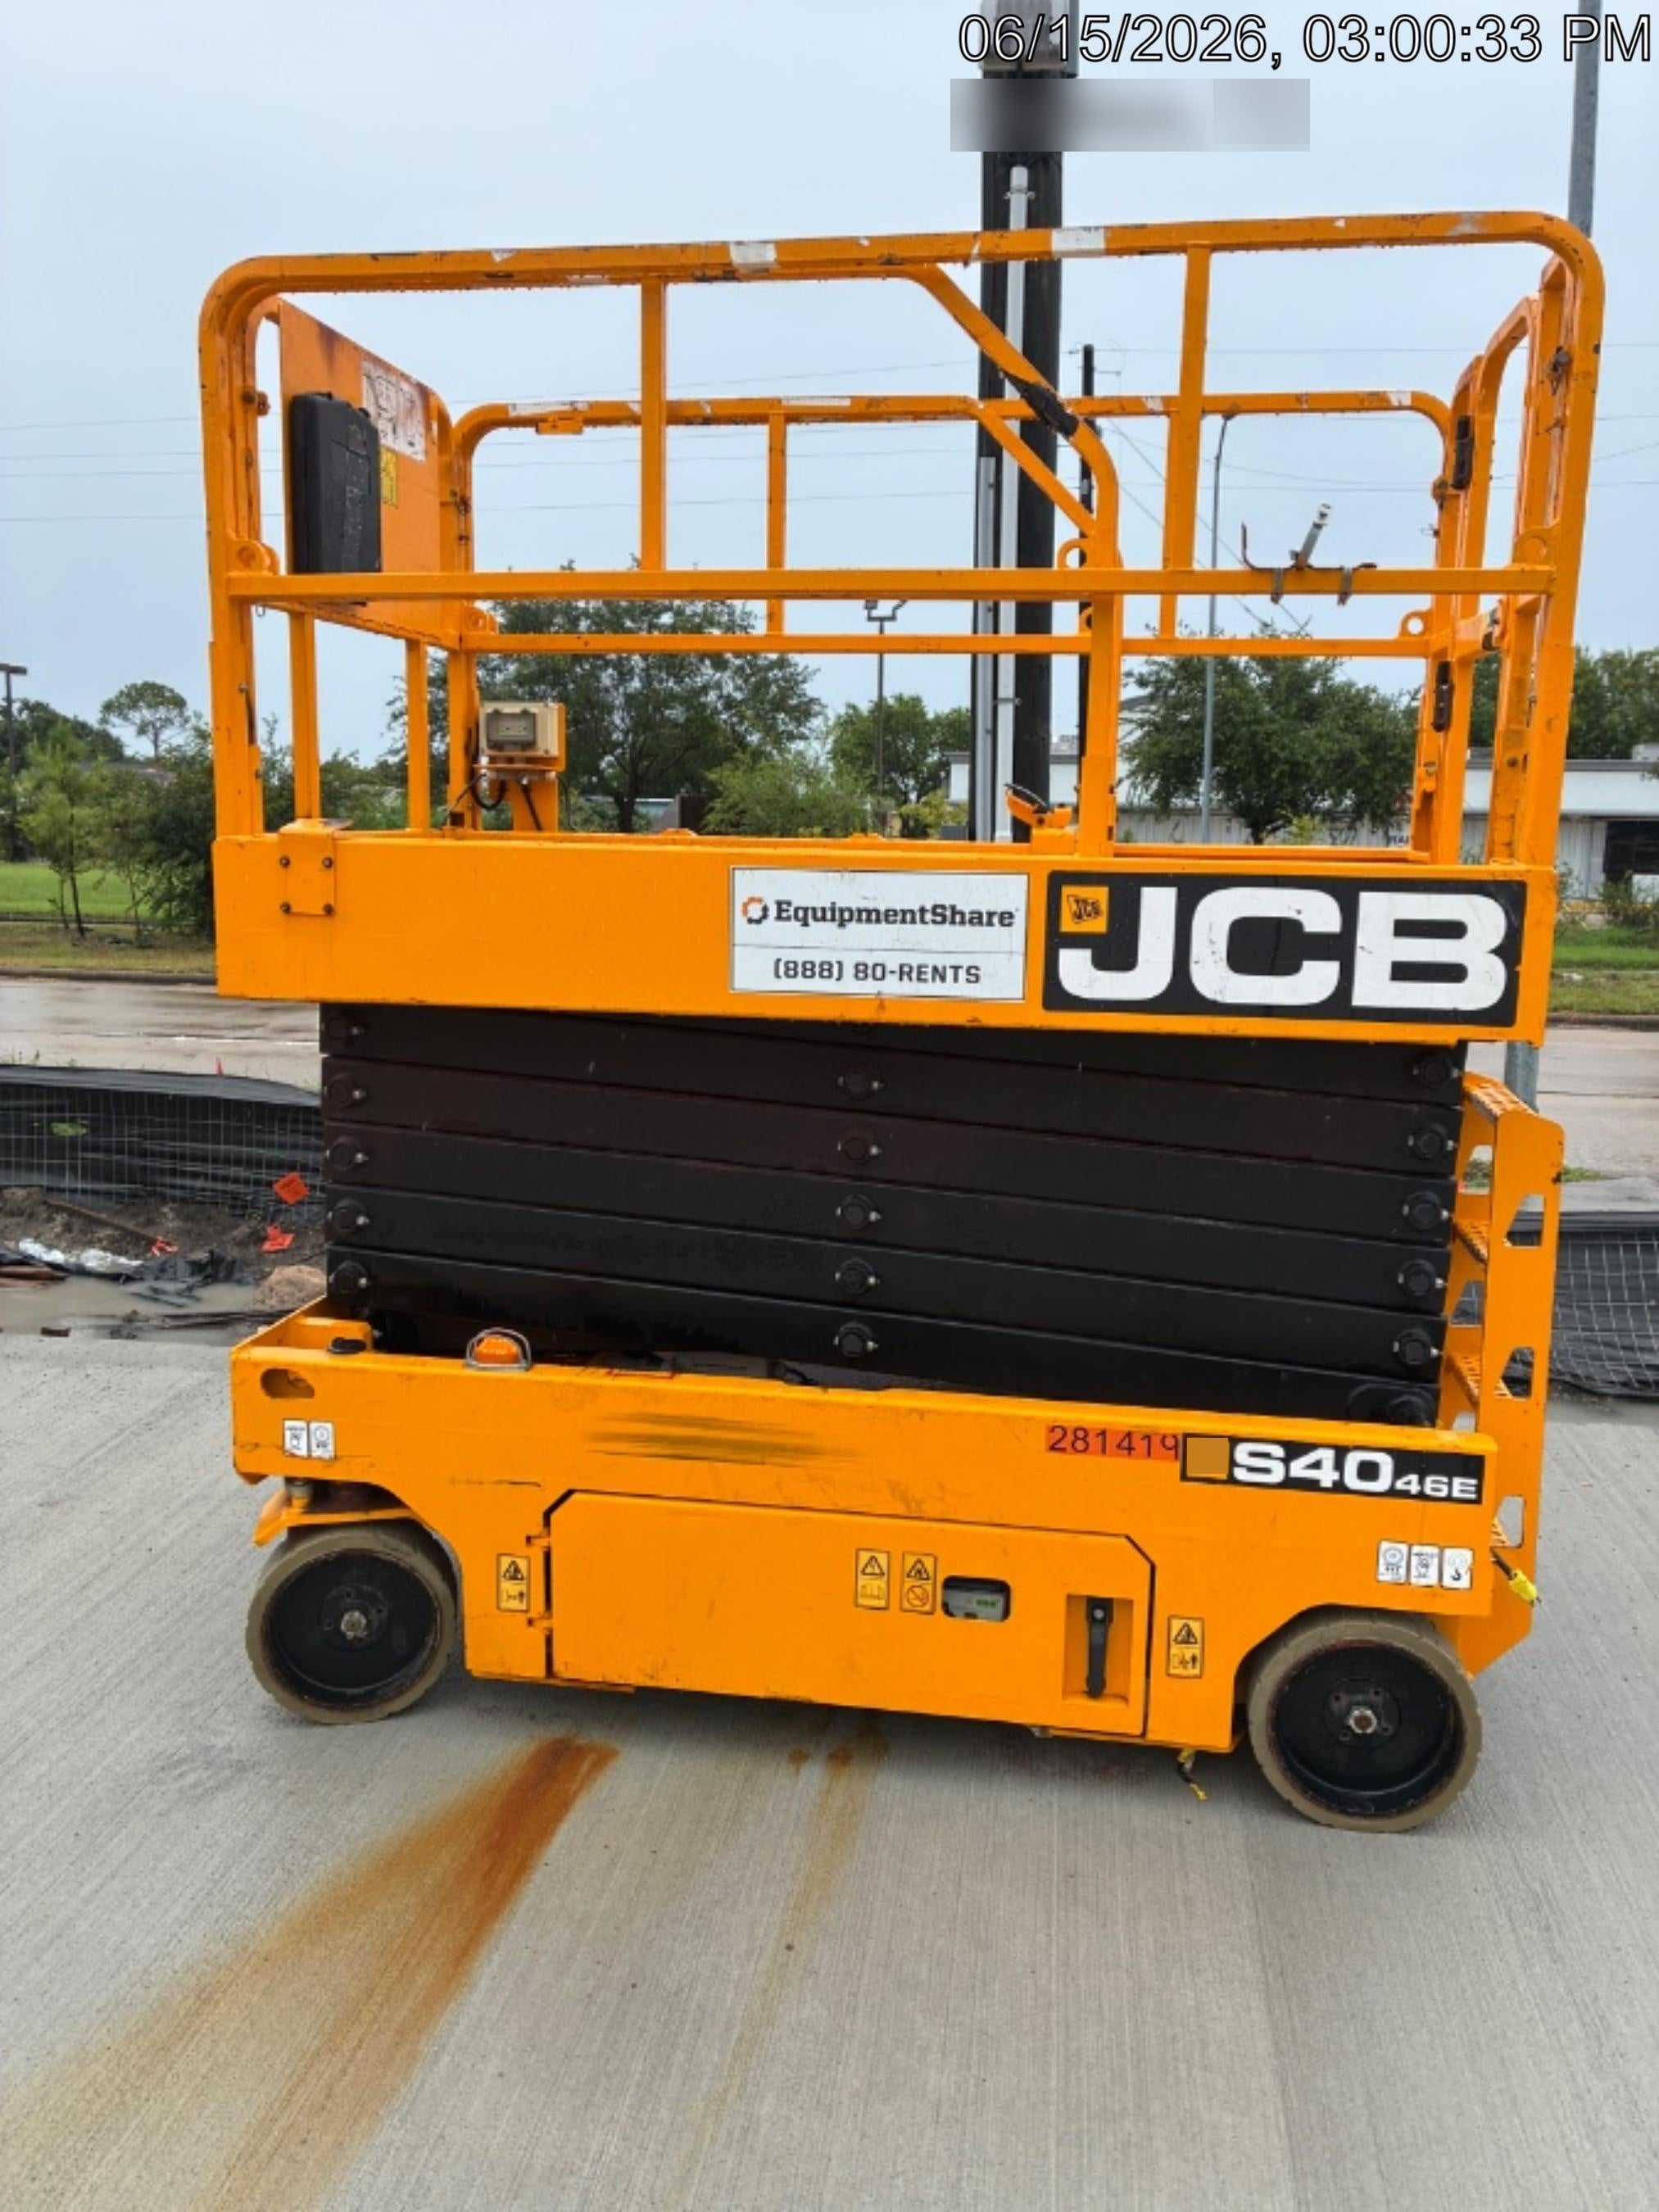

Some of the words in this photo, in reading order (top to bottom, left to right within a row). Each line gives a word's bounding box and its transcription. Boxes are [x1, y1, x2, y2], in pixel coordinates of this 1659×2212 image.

[774, 900, 1014, 928] EquipmentShare
[1057, 885, 1507, 1011] JCB
[773, 958, 844, 981] (888)
[853, 962, 981, 984] 80-RENTS
[1048, 1424, 1180, 1462] 281419
